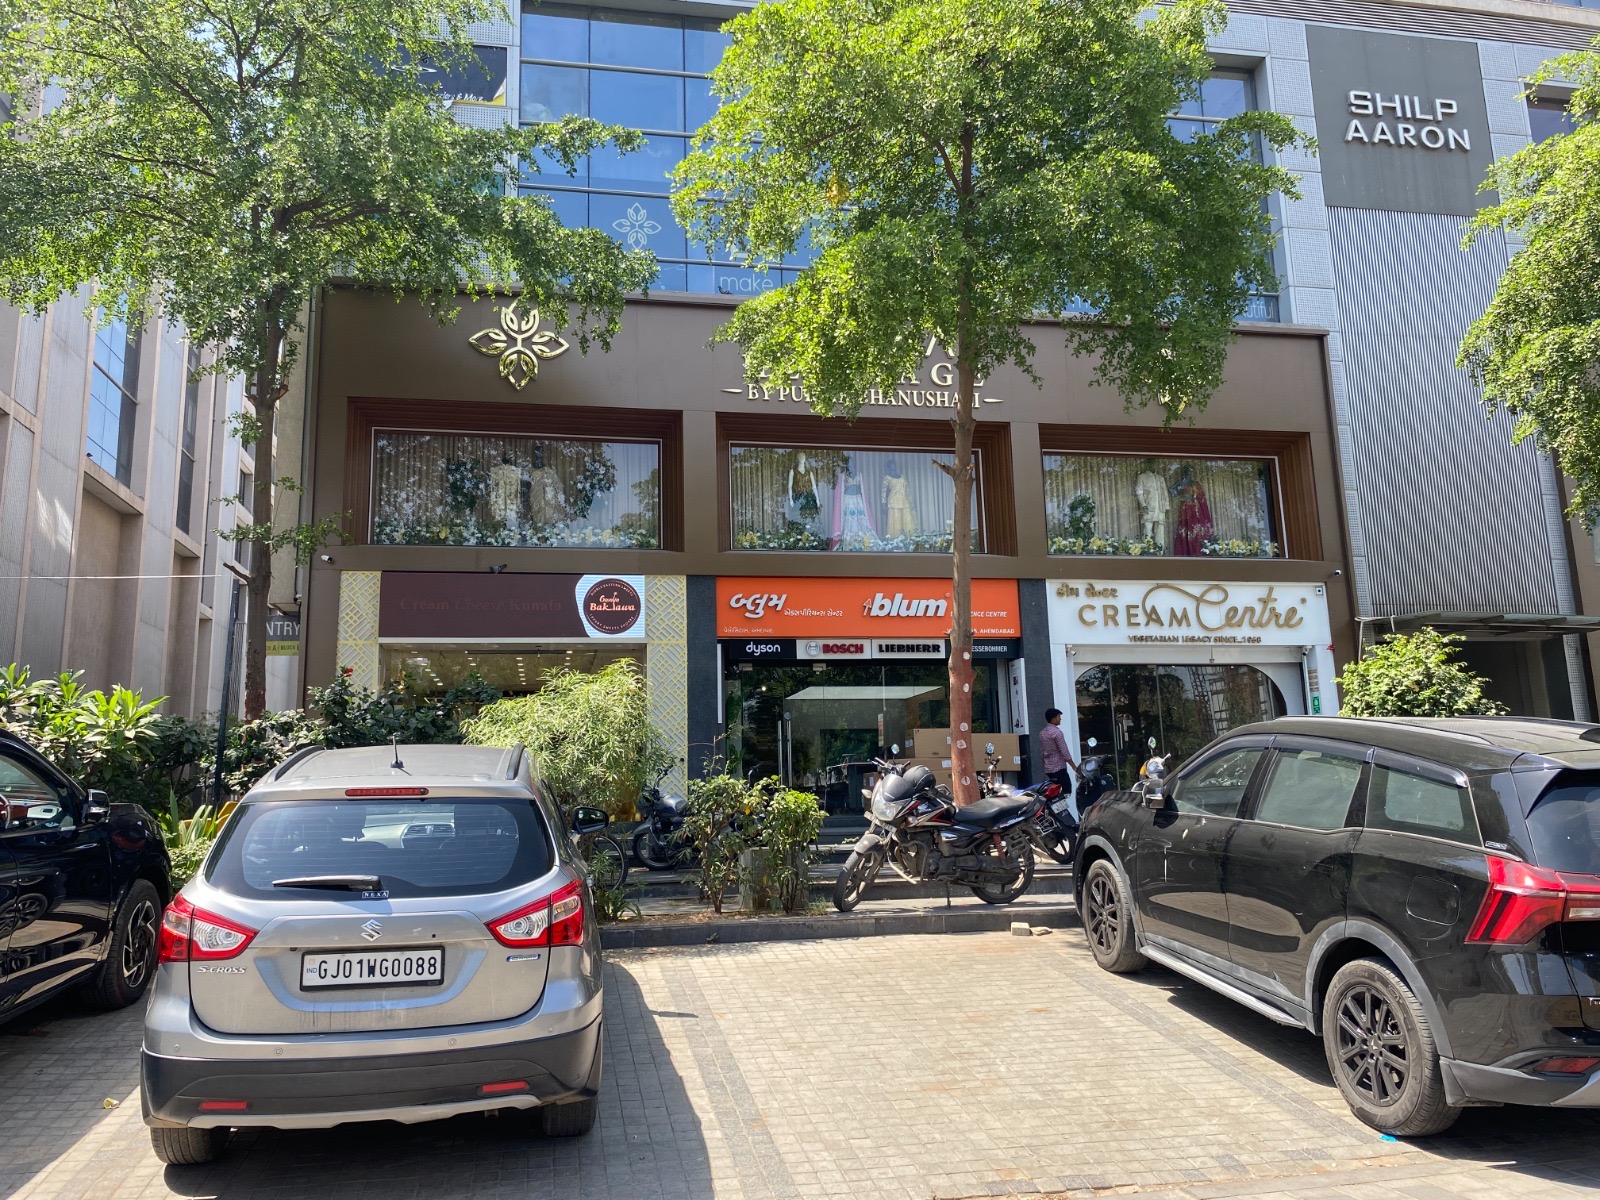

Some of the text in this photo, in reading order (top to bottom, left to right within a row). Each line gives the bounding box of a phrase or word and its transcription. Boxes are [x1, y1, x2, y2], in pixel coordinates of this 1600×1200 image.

[1348, 90, 1458, 122] SHILP
[1345, 119, 1471, 151] AARON
[720, 273, 773, 292] make
[747, 383, 770, 400] BY
[399, 597, 449, 611] Cream
[511, 596, 562, 611] Kunafa
[590, 602, 635, 611] Baklawa
[871, 592, 948, 617] blum
[1078, 584, 1304, 632] CREAM Centre
[266, 621, 300, 636] NTRY
[1128, 635, 1179, 643] VEGETARIAN
[1182, 635, 1212, 643] LEGACY
[746, 642, 781, 656] dyson
[822, 643, 864, 654] BOSCH
[878, 643, 941, 654] LIEBHERR
[197, 965, 247, 974] S-CROSS
[318, 956, 437, 979] GJ01WG0088
